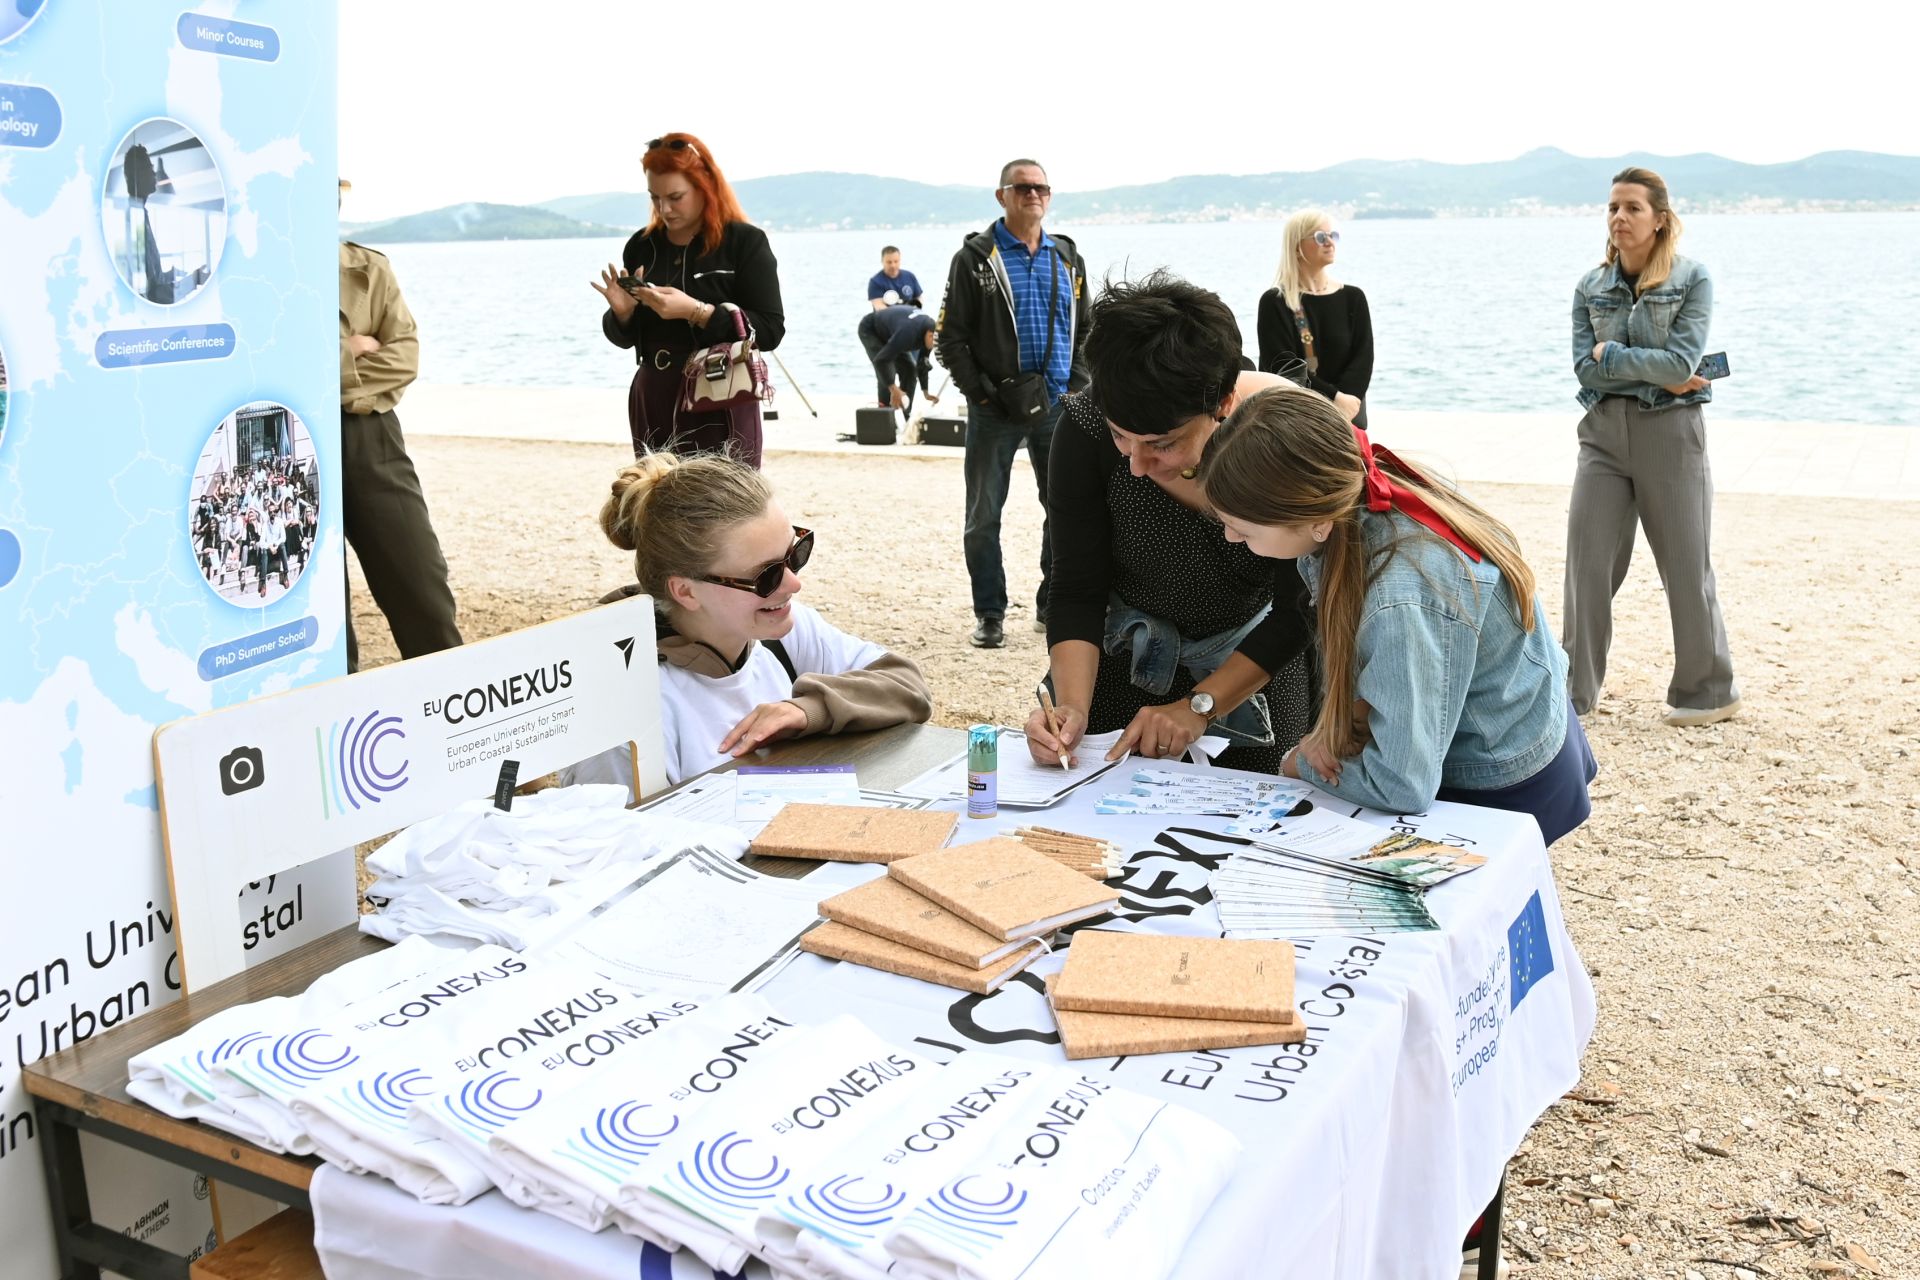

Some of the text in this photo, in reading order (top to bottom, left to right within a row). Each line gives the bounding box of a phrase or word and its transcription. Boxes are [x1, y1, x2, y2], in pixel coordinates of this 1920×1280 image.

[196, 26, 265, 50] Minor Courses
[0, 117, 39, 137] ology
[1, 96, 14, 112] in
[108, 335, 225, 357] Scientific Conferences
[215, 627, 307, 668] PhD Summer School
[447, 706, 576, 759] European University for Smart
[448, 723, 569, 773] Urban Coastal Sustainability
[378, 956, 528, 1029] CONEXUS
[17, 980, 150, 1070] Urban
[454, 1055, 478, 1073] EU
[477, 986, 619, 1070] CONEXUS
[541, 1000, 700, 1072] EU CONEXUS
[770, 1053, 917, 1135] EU CONEXUS
[903, 1069, 1033, 1153] CONEXUS
[140, 1212, 171, 1242] ATHENS
